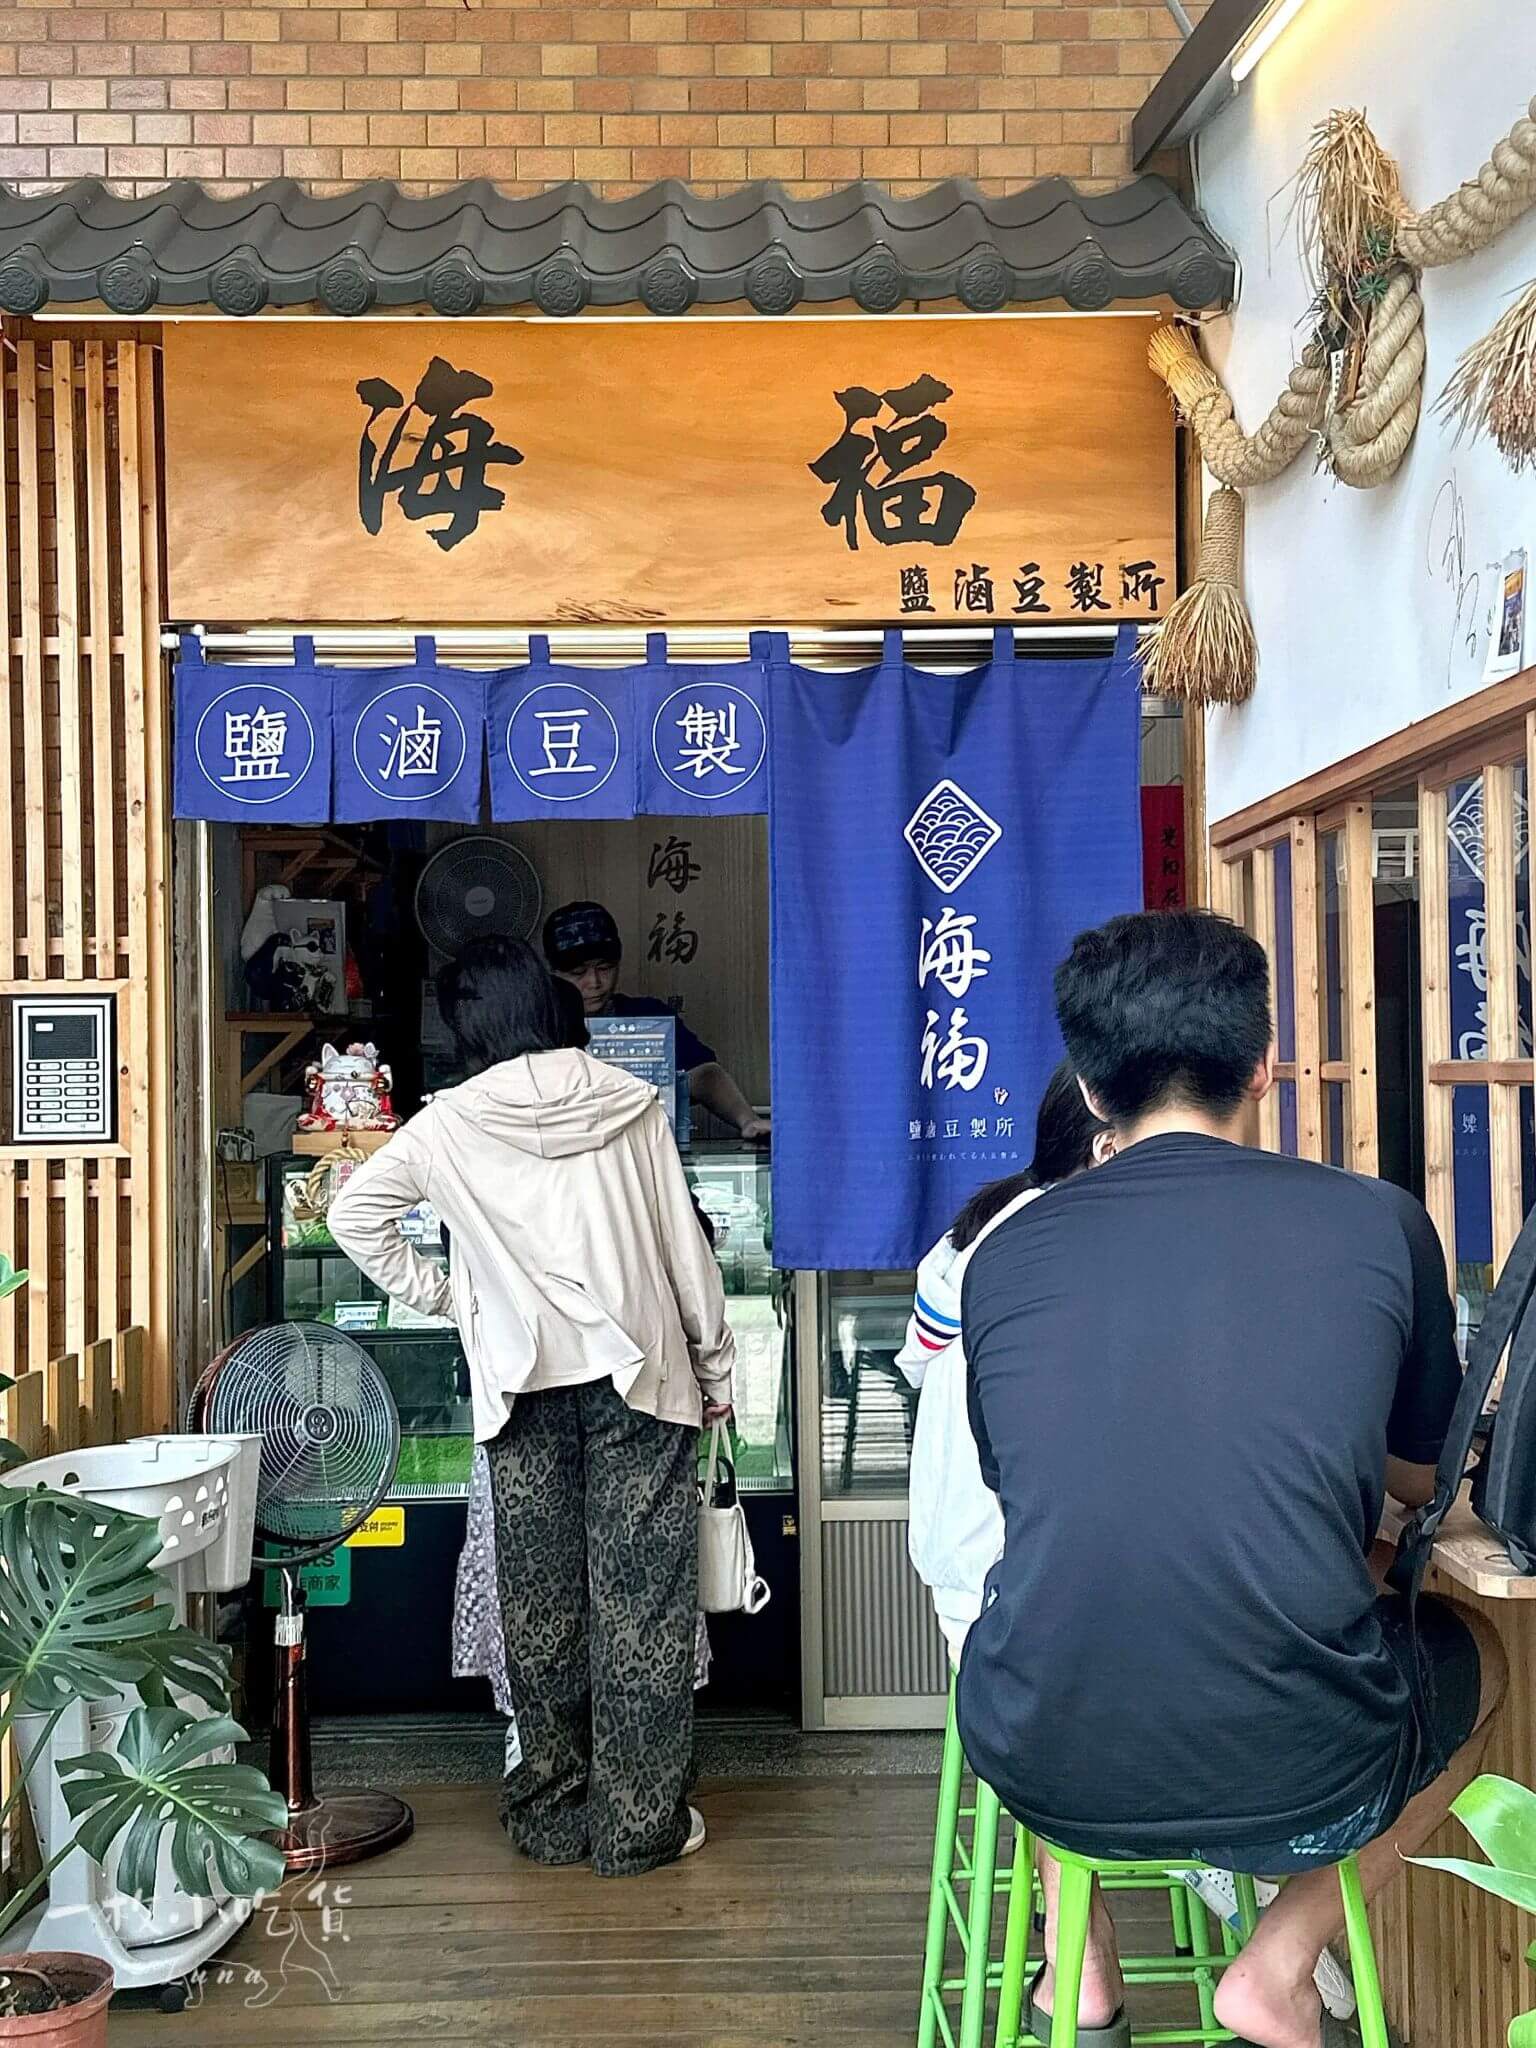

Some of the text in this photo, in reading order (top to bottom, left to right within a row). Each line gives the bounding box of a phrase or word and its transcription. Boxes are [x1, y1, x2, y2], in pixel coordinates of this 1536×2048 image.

[900, 561, 1166, 614] 鹽滷豆製所
[919, 906, 992, 1092] 海福
